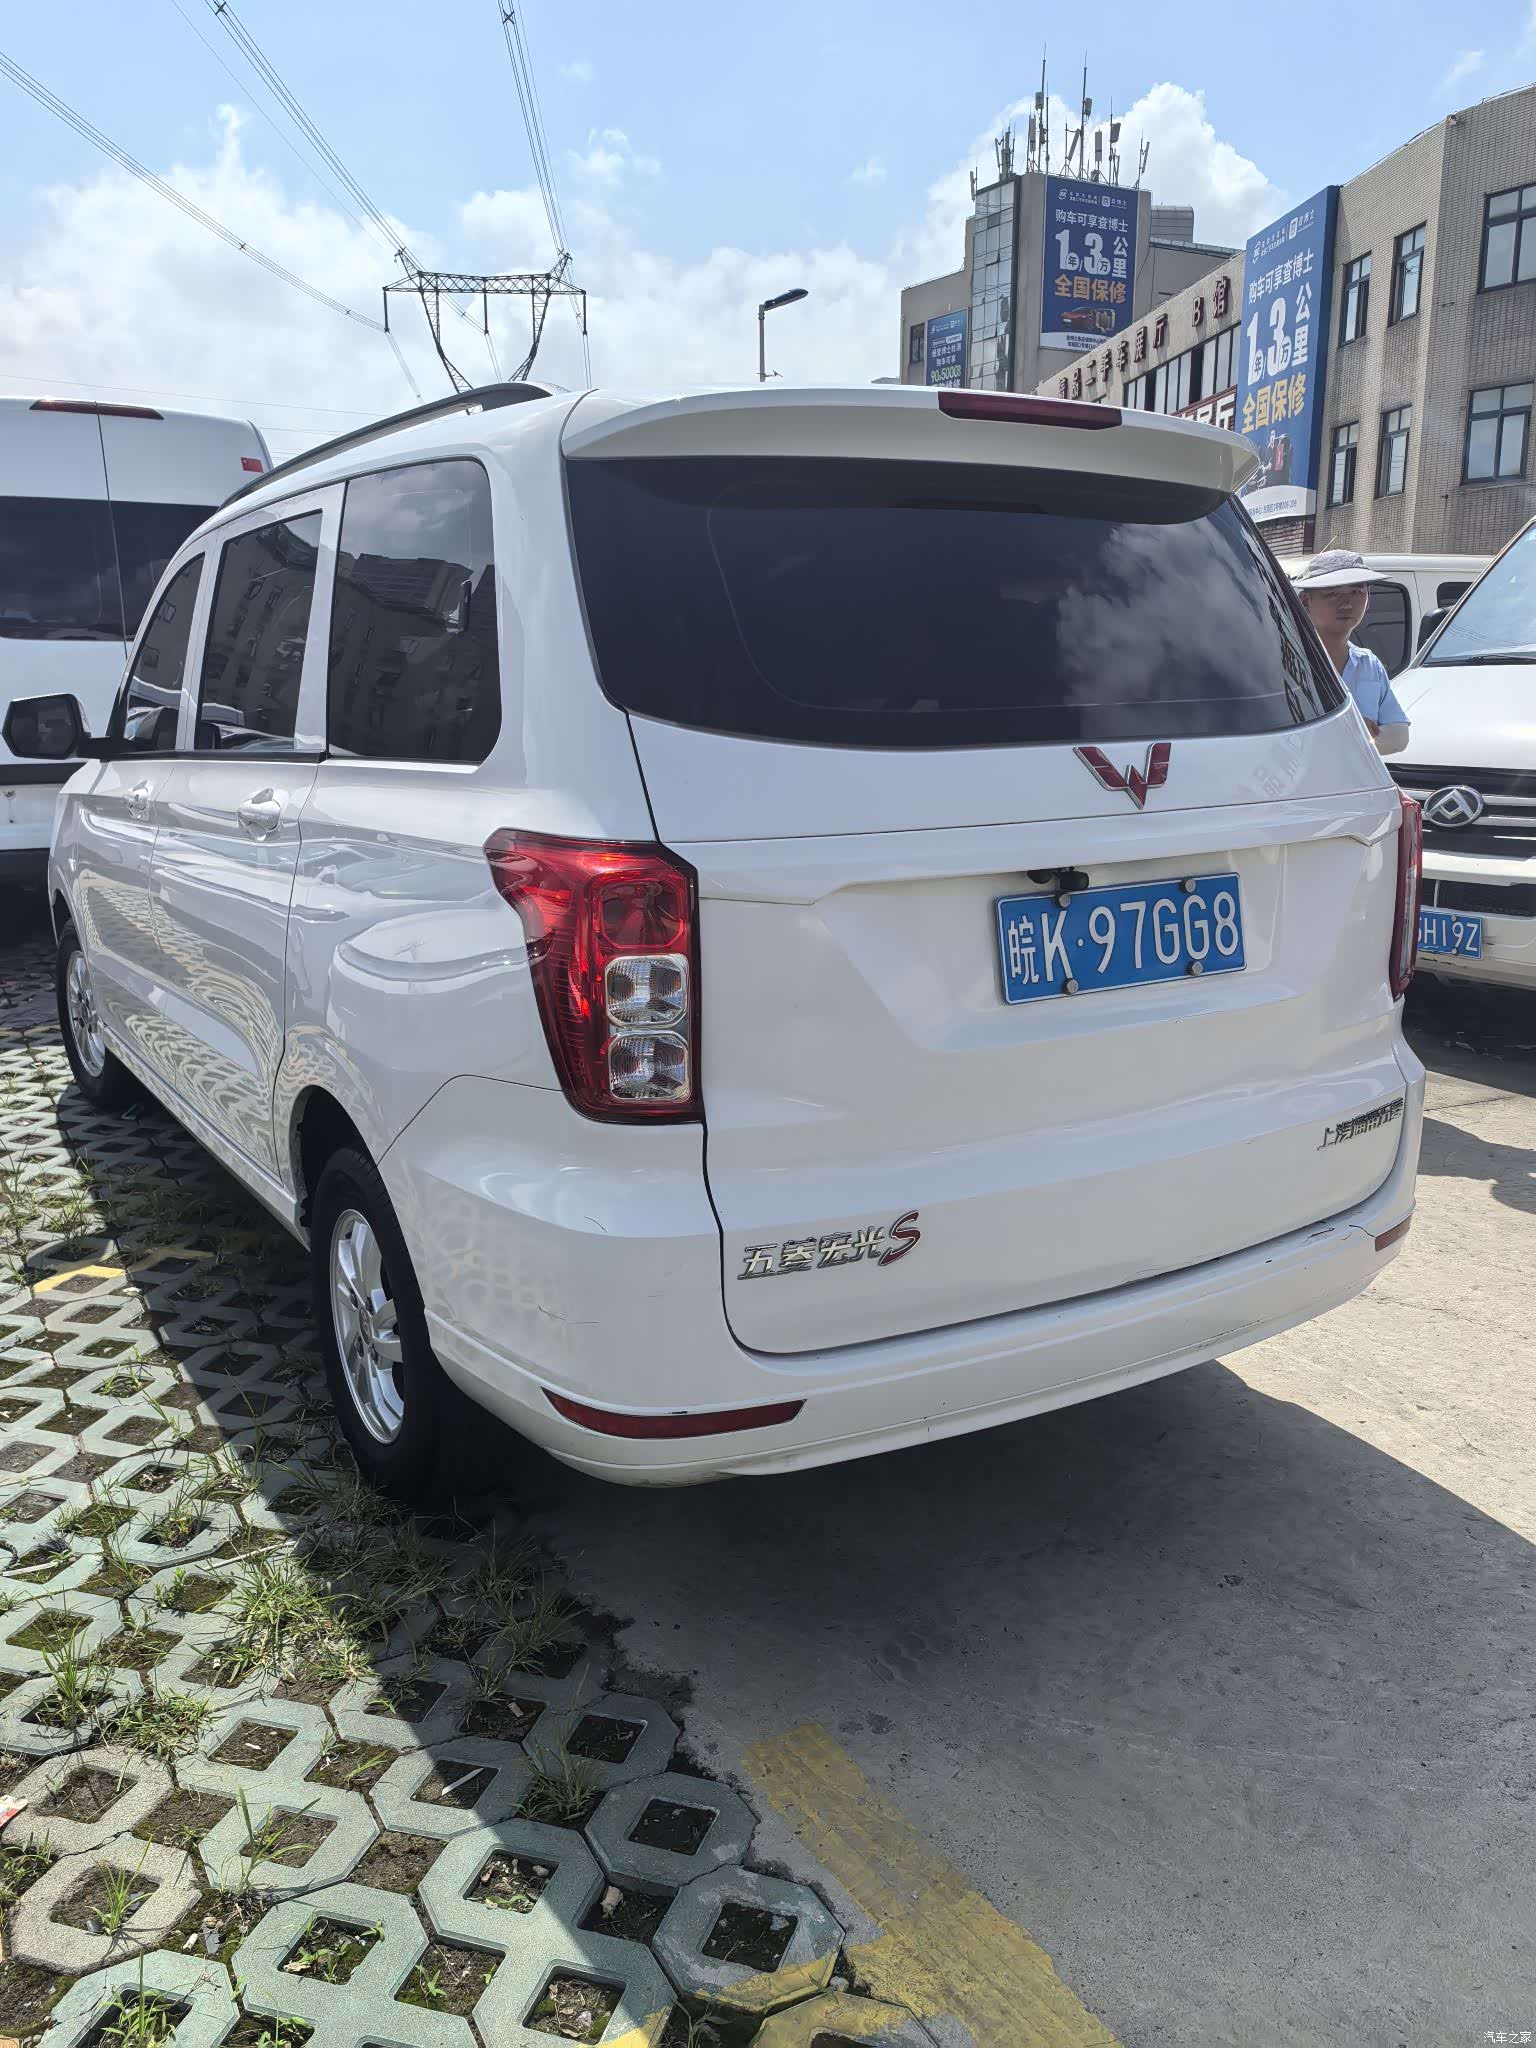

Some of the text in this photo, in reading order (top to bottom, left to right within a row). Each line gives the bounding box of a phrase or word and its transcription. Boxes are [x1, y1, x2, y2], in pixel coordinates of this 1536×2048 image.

[1055, 208, 1129, 233] 购车可享查博士
[1054, 274, 1126, 304] 全国保修
[1248, 250, 1314, 304] 购车可享查博士
[1241, 373, 1307, 434] 全国保修
